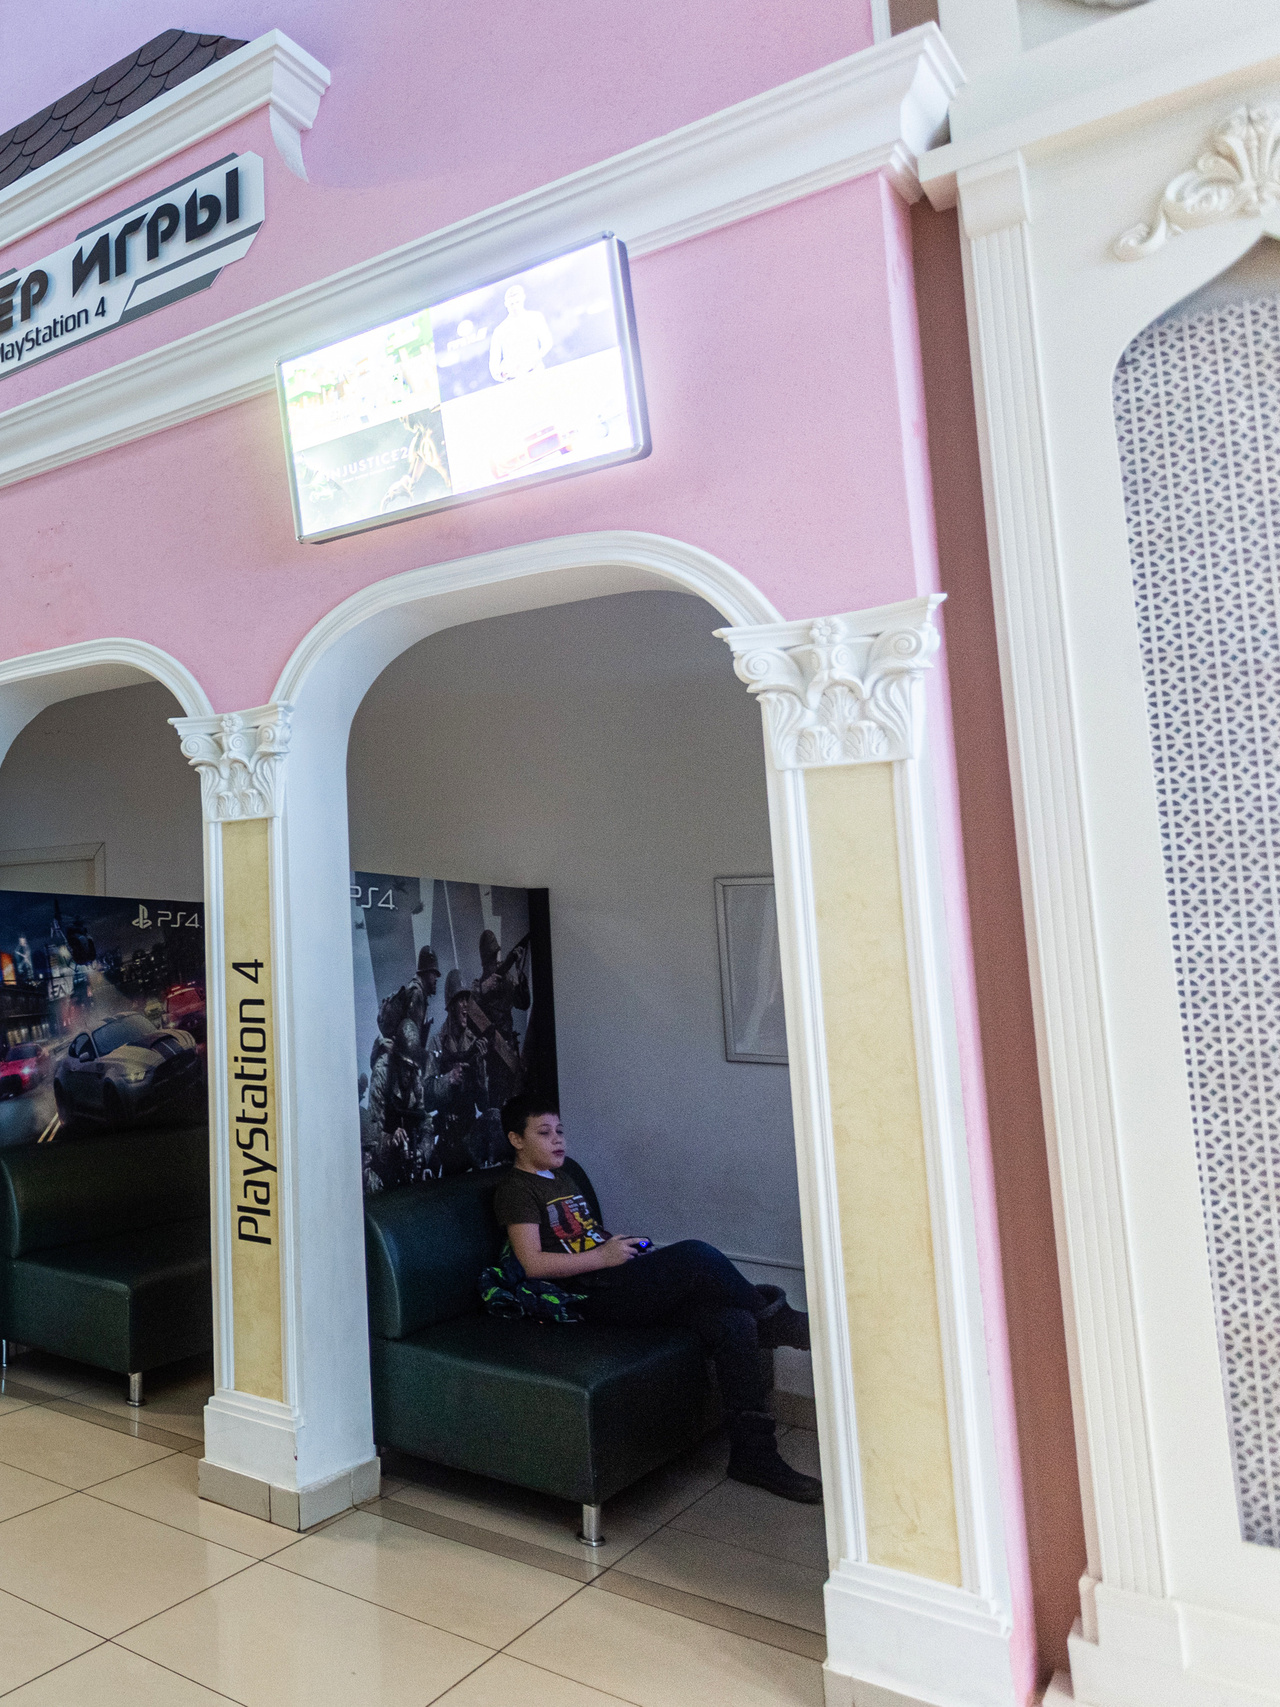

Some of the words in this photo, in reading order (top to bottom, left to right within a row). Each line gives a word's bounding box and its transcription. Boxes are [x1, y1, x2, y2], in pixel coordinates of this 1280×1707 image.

[72, 167, 239, 297] ИГРЫ
[94, 296, 107, 318] 4
[350, 885, 396, 910] PS4
[157, 911, 202, 929] PS4
[231, 959, 265, 984] 4
[233, 999, 278, 1246] PlayStation
